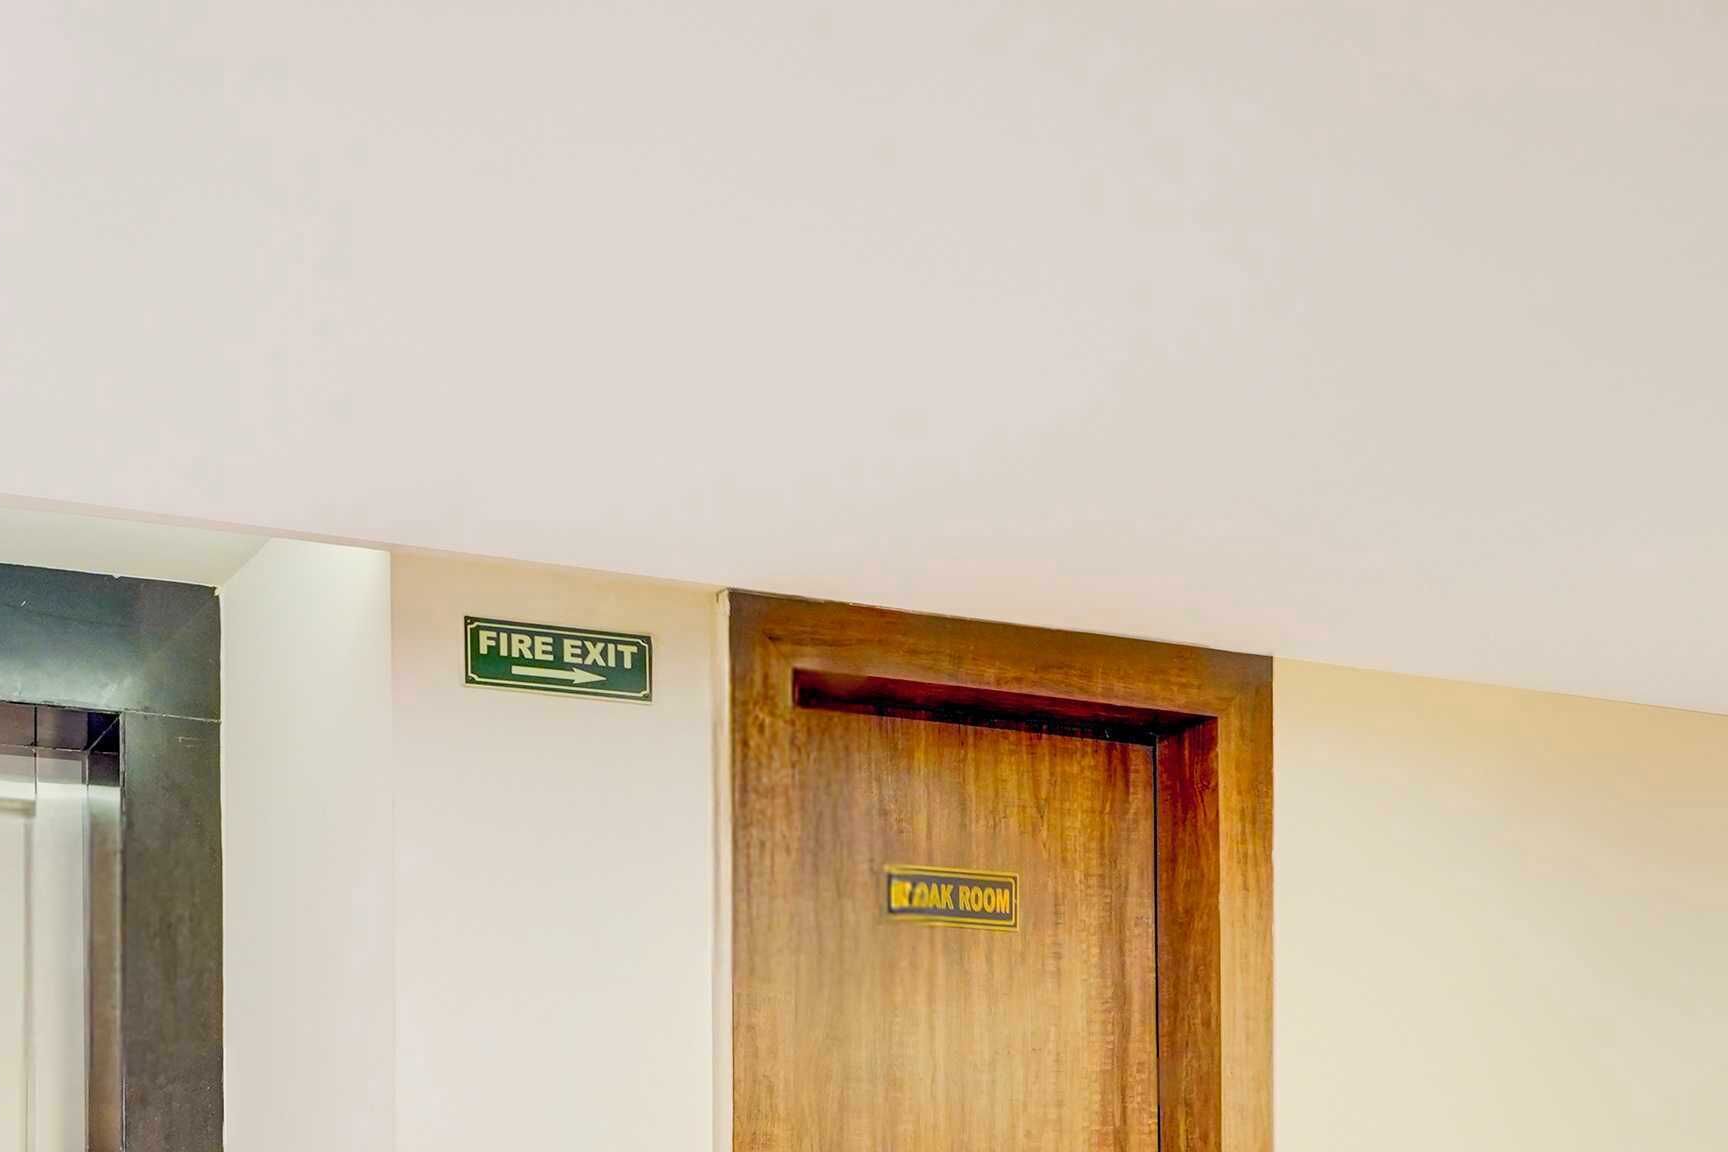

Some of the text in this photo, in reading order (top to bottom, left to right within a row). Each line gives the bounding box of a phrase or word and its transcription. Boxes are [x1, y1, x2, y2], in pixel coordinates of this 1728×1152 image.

[478, 630, 638, 669] FIRE EXIT
[959, 885, 1010, 914] ROOM
